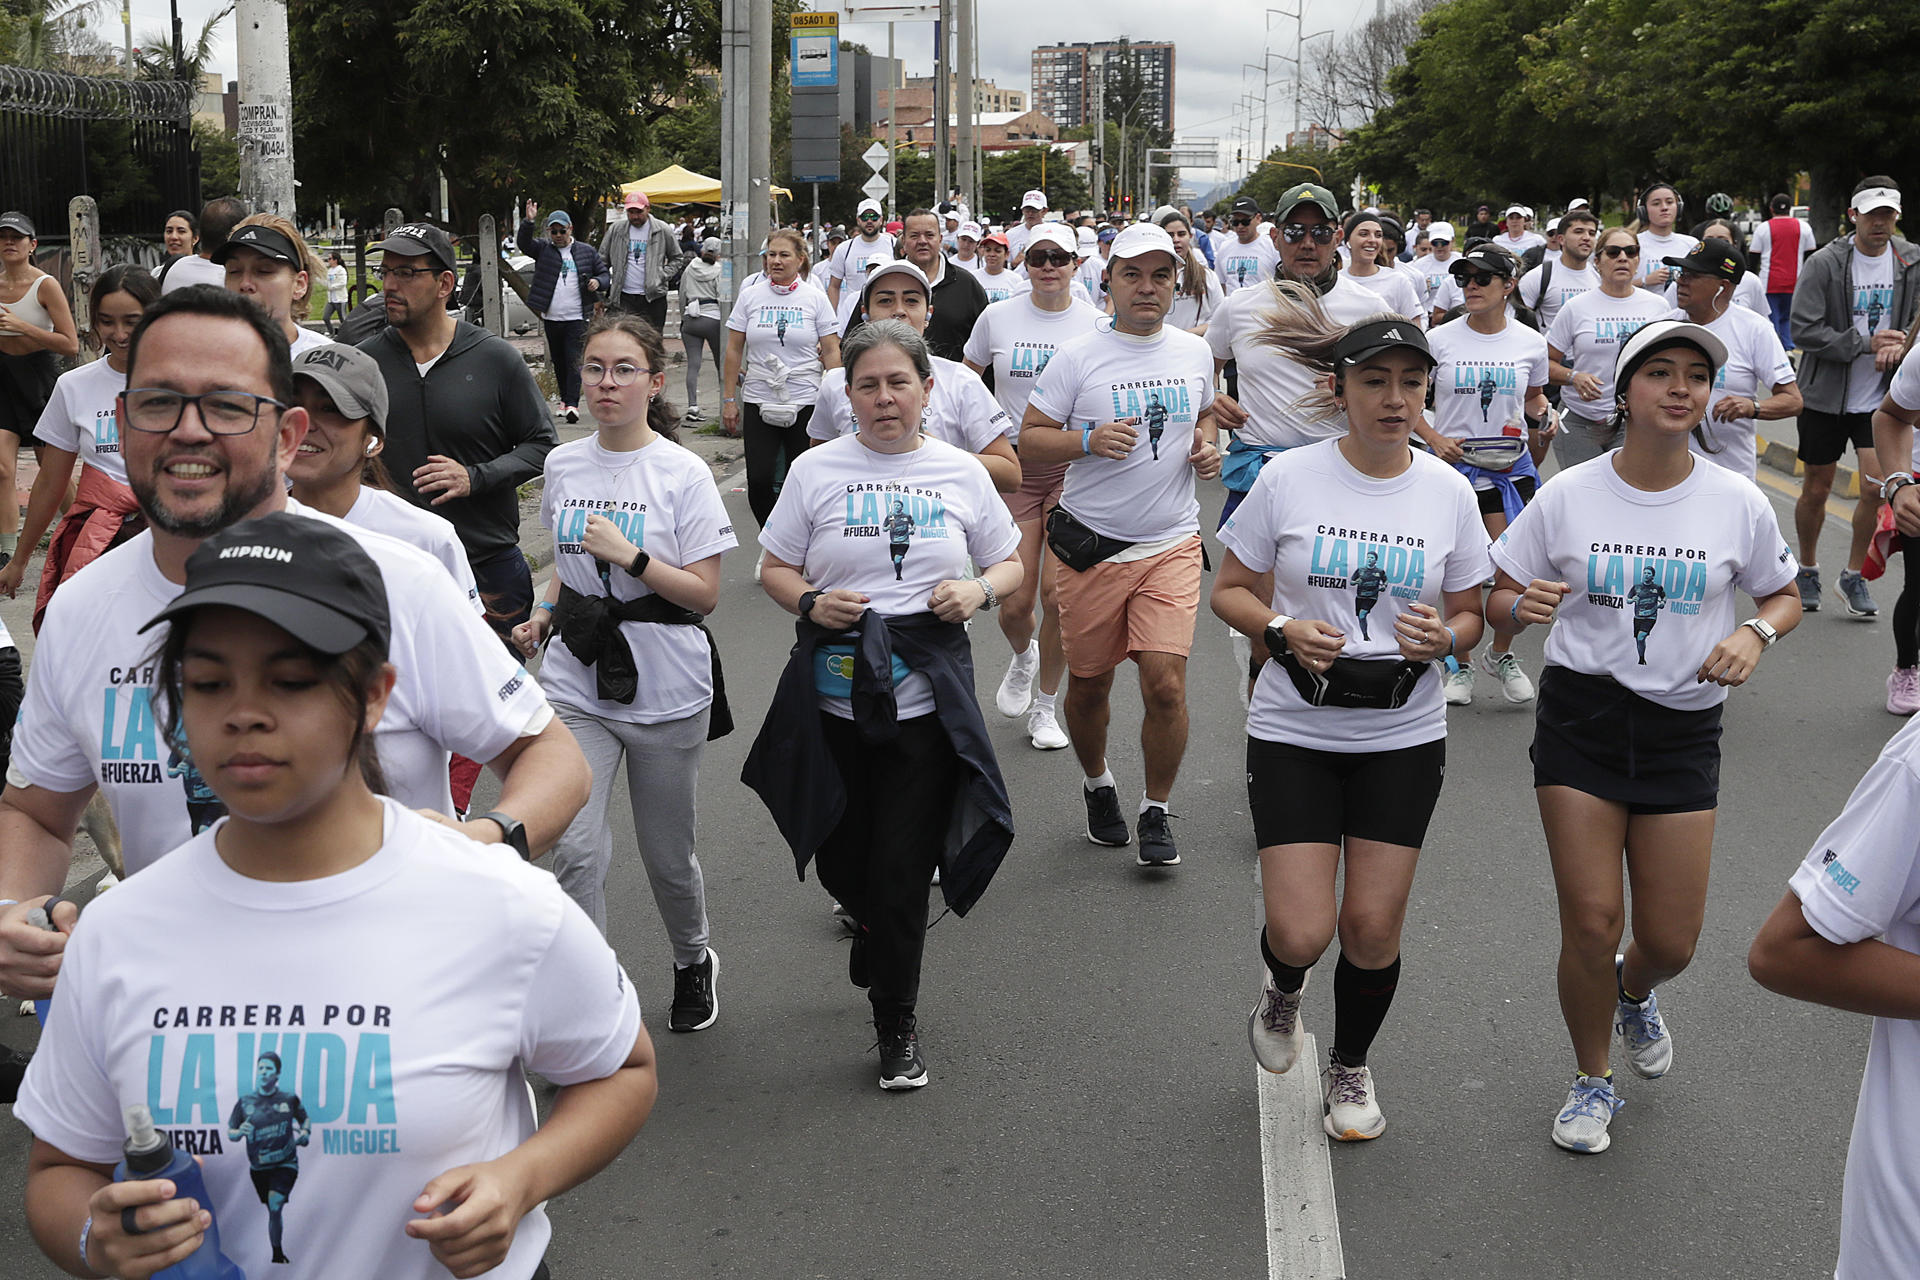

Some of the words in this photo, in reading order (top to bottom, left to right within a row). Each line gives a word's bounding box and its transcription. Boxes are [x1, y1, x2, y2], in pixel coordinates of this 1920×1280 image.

[760, 311, 774, 324] LA
[1596, 322, 1615, 338] LA
[304, 349, 350, 372] CAT
[1011, 348, 1033, 370] LA
[1111, 380, 1163, 391] CARRERA
[1167, 378, 1187, 386] POR
[1455, 367, 1476, 387] LA
[1112, 391, 1142, 418] LA
[96, 418, 119, 444] LA
[847, 484, 910, 494] CARRERA
[916, 488, 943, 499] POR
[622, 501, 647, 512] POR
[846, 492, 880, 526] LA
[558, 509, 585, 542] LA
[843, 526, 880, 538] #FUERZA
[1317, 525, 1389, 543] CARRERA
[1396, 535, 1425, 548] POR
[219, 545, 293, 564] KIPRUN
[1310, 535, 1348, 577] LA
[1357, 541, 1425, 589] VIDA
[1590, 543, 1667, 557] CARRERA
[1674, 548, 1706, 560] POR
[1307, 575, 1347, 589] #FUERZA
[1390, 585, 1421, 600] MIGUEL
[1587, 554, 1624, 595] LA
[1633, 556, 1707, 602] VIDA
[1588, 593, 1624, 609] #FUERZA
[101, 687, 158, 761] LA
[101, 762, 163, 783] #FUERZA
[153, 1004, 305, 1029] CARRERA
[323, 1004, 391, 1027] POR
[146, 1033, 220, 1126] LA
[236, 1032, 398, 1125] VIDA
[322, 1128, 401, 1156] MIGUEL
